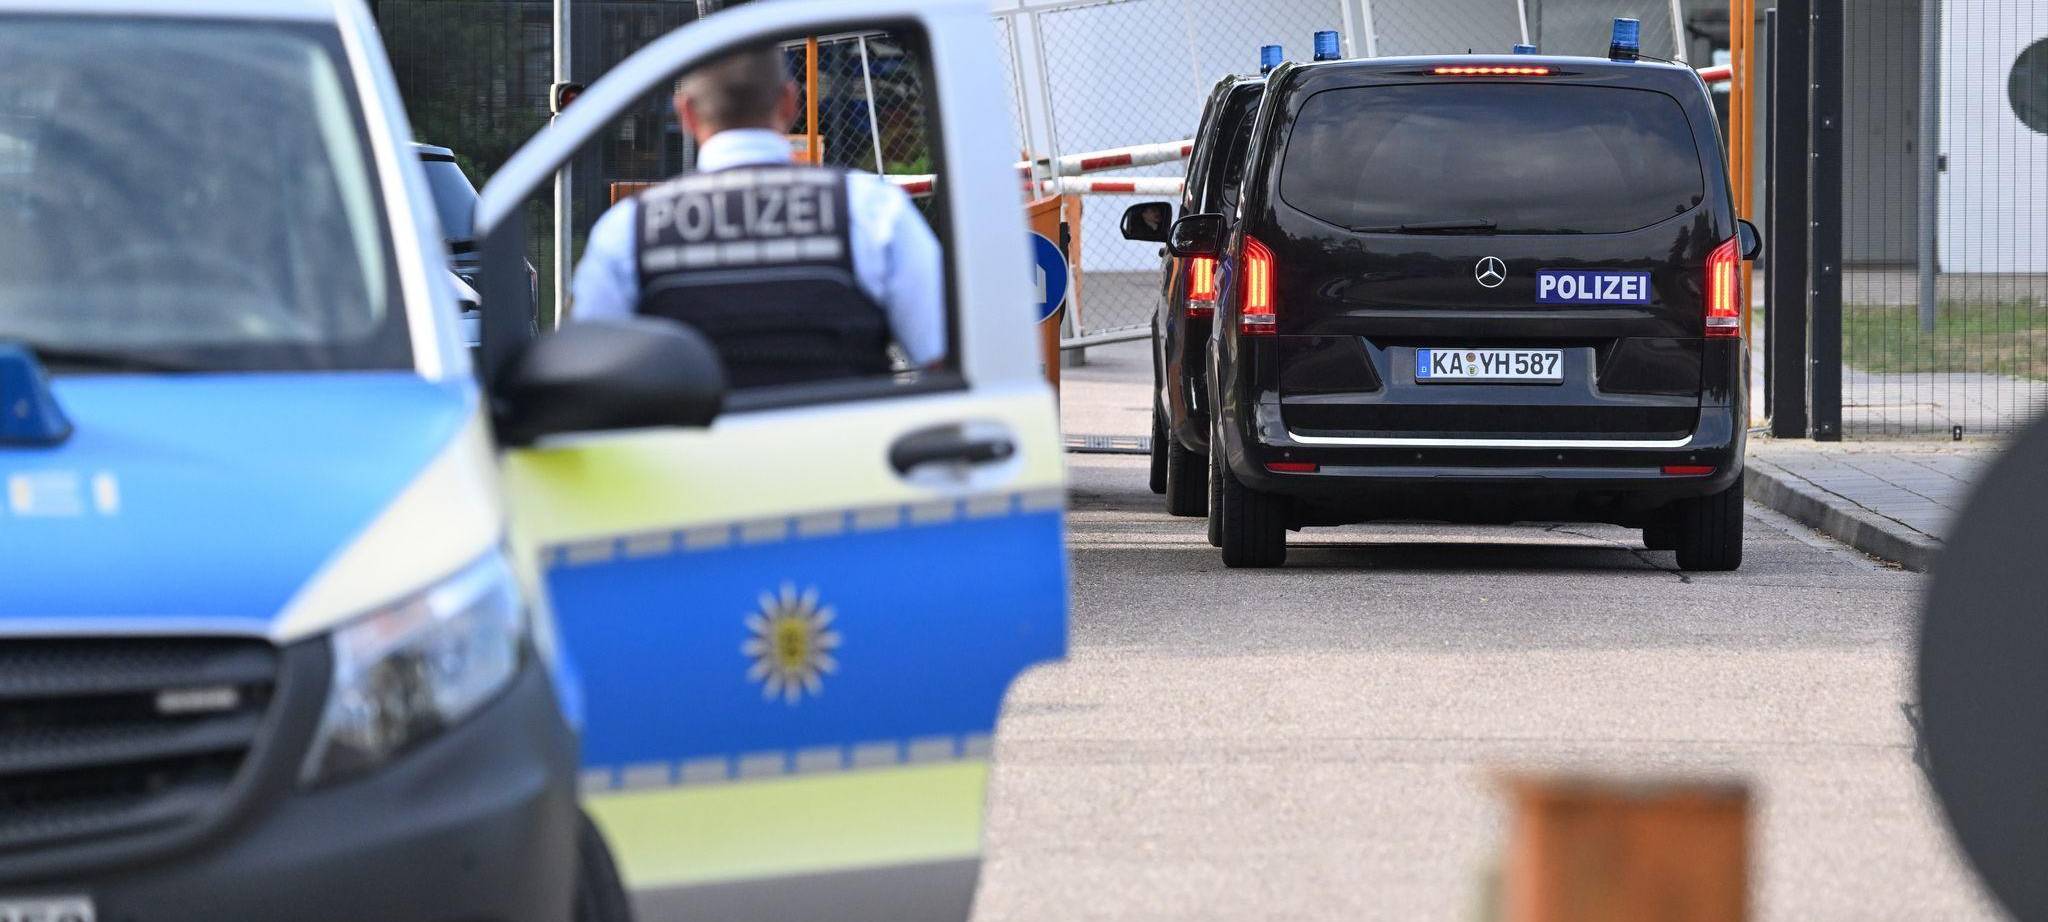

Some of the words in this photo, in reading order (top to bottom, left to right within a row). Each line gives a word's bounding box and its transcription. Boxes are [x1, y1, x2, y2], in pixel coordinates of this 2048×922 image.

[645, 186, 835, 244] POLIZEI
[1540, 275, 1647, 300] POLIZEI
[1433, 352, 1463, 374] KA
[1480, 352, 1510, 374] YH
[1515, 352, 1559, 375] 587
[0, 471, 119, 516] EI
